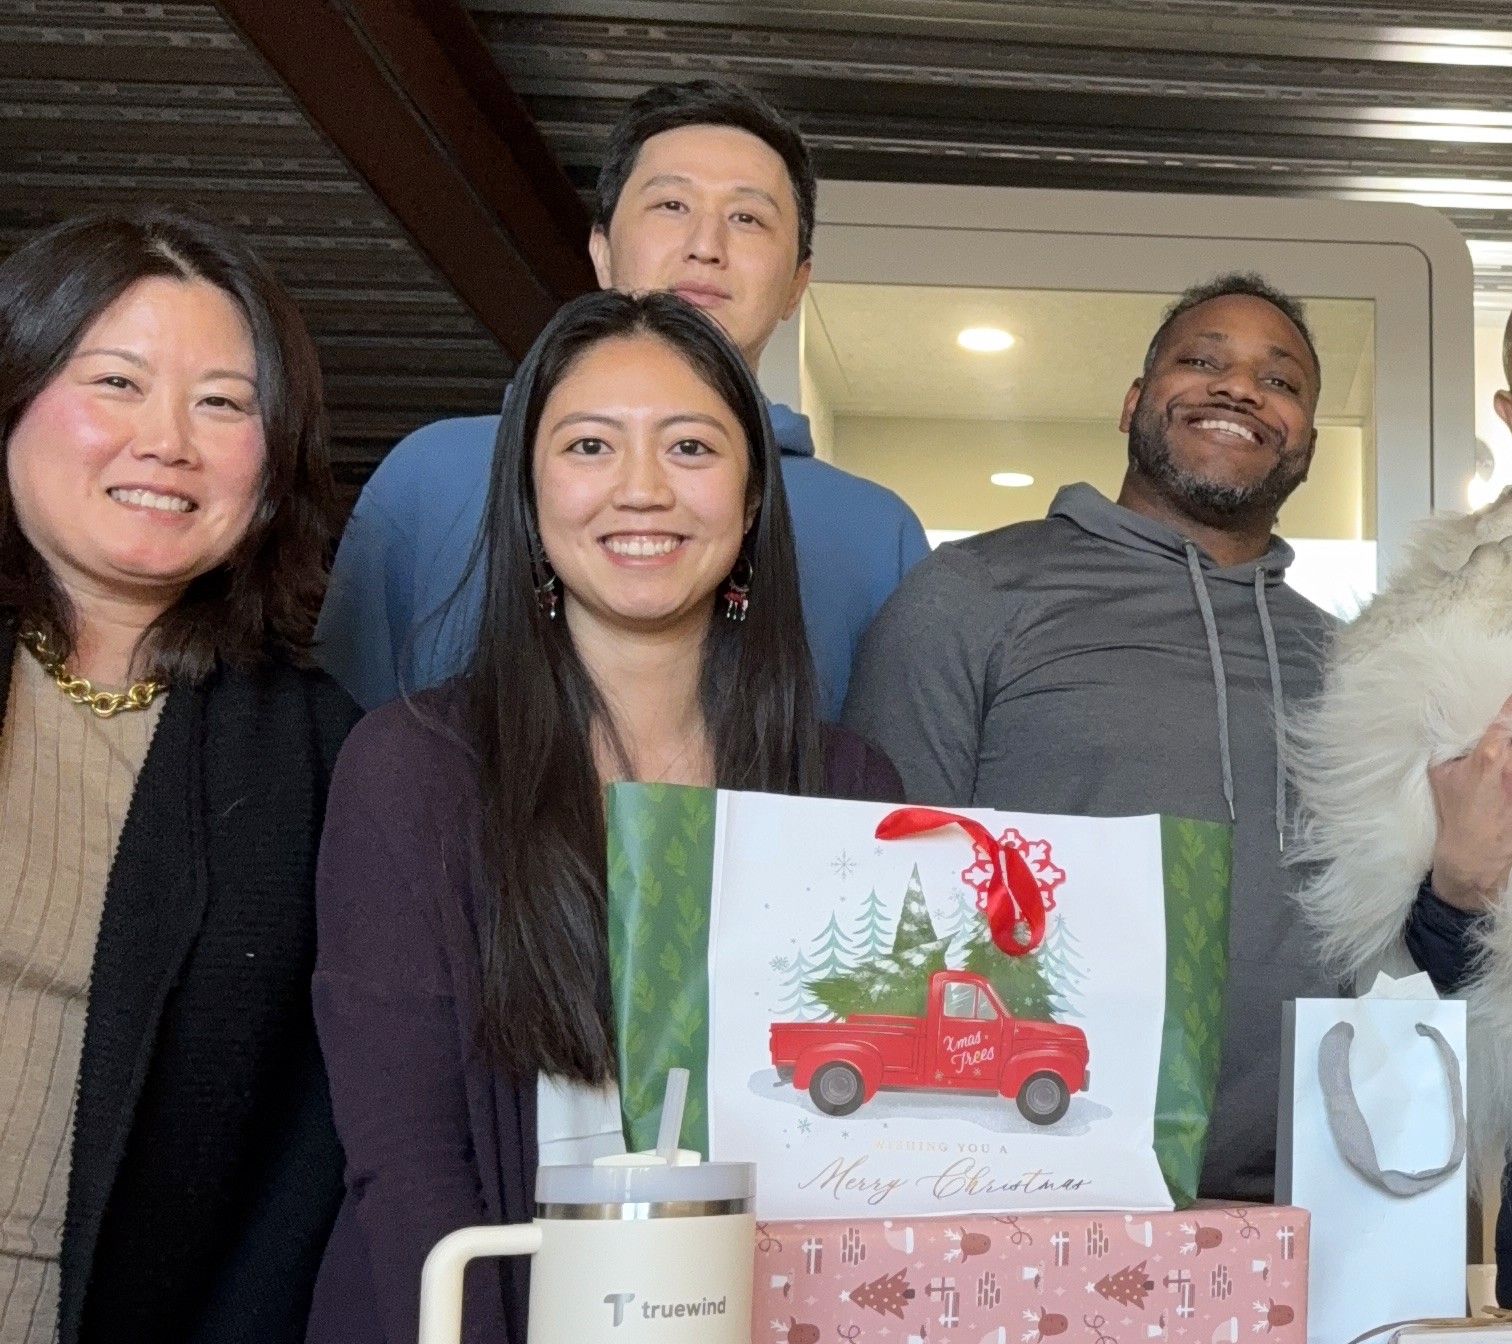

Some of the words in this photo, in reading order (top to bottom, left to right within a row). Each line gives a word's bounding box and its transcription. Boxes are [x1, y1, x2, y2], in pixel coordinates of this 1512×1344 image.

[943, 1030, 982, 1053] Xmas
[951, 1046, 995, 1074] Trees
[873, 1139, 949, 1153] WISHING
[957, 1142, 991, 1154] YOU
[998, 1144, 1009, 1154] A
[797, 1154, 909, 1206] Merry
[915, 1157, 1093, 1200] Christmas
[641, 1296, 727, 1319] truewind
